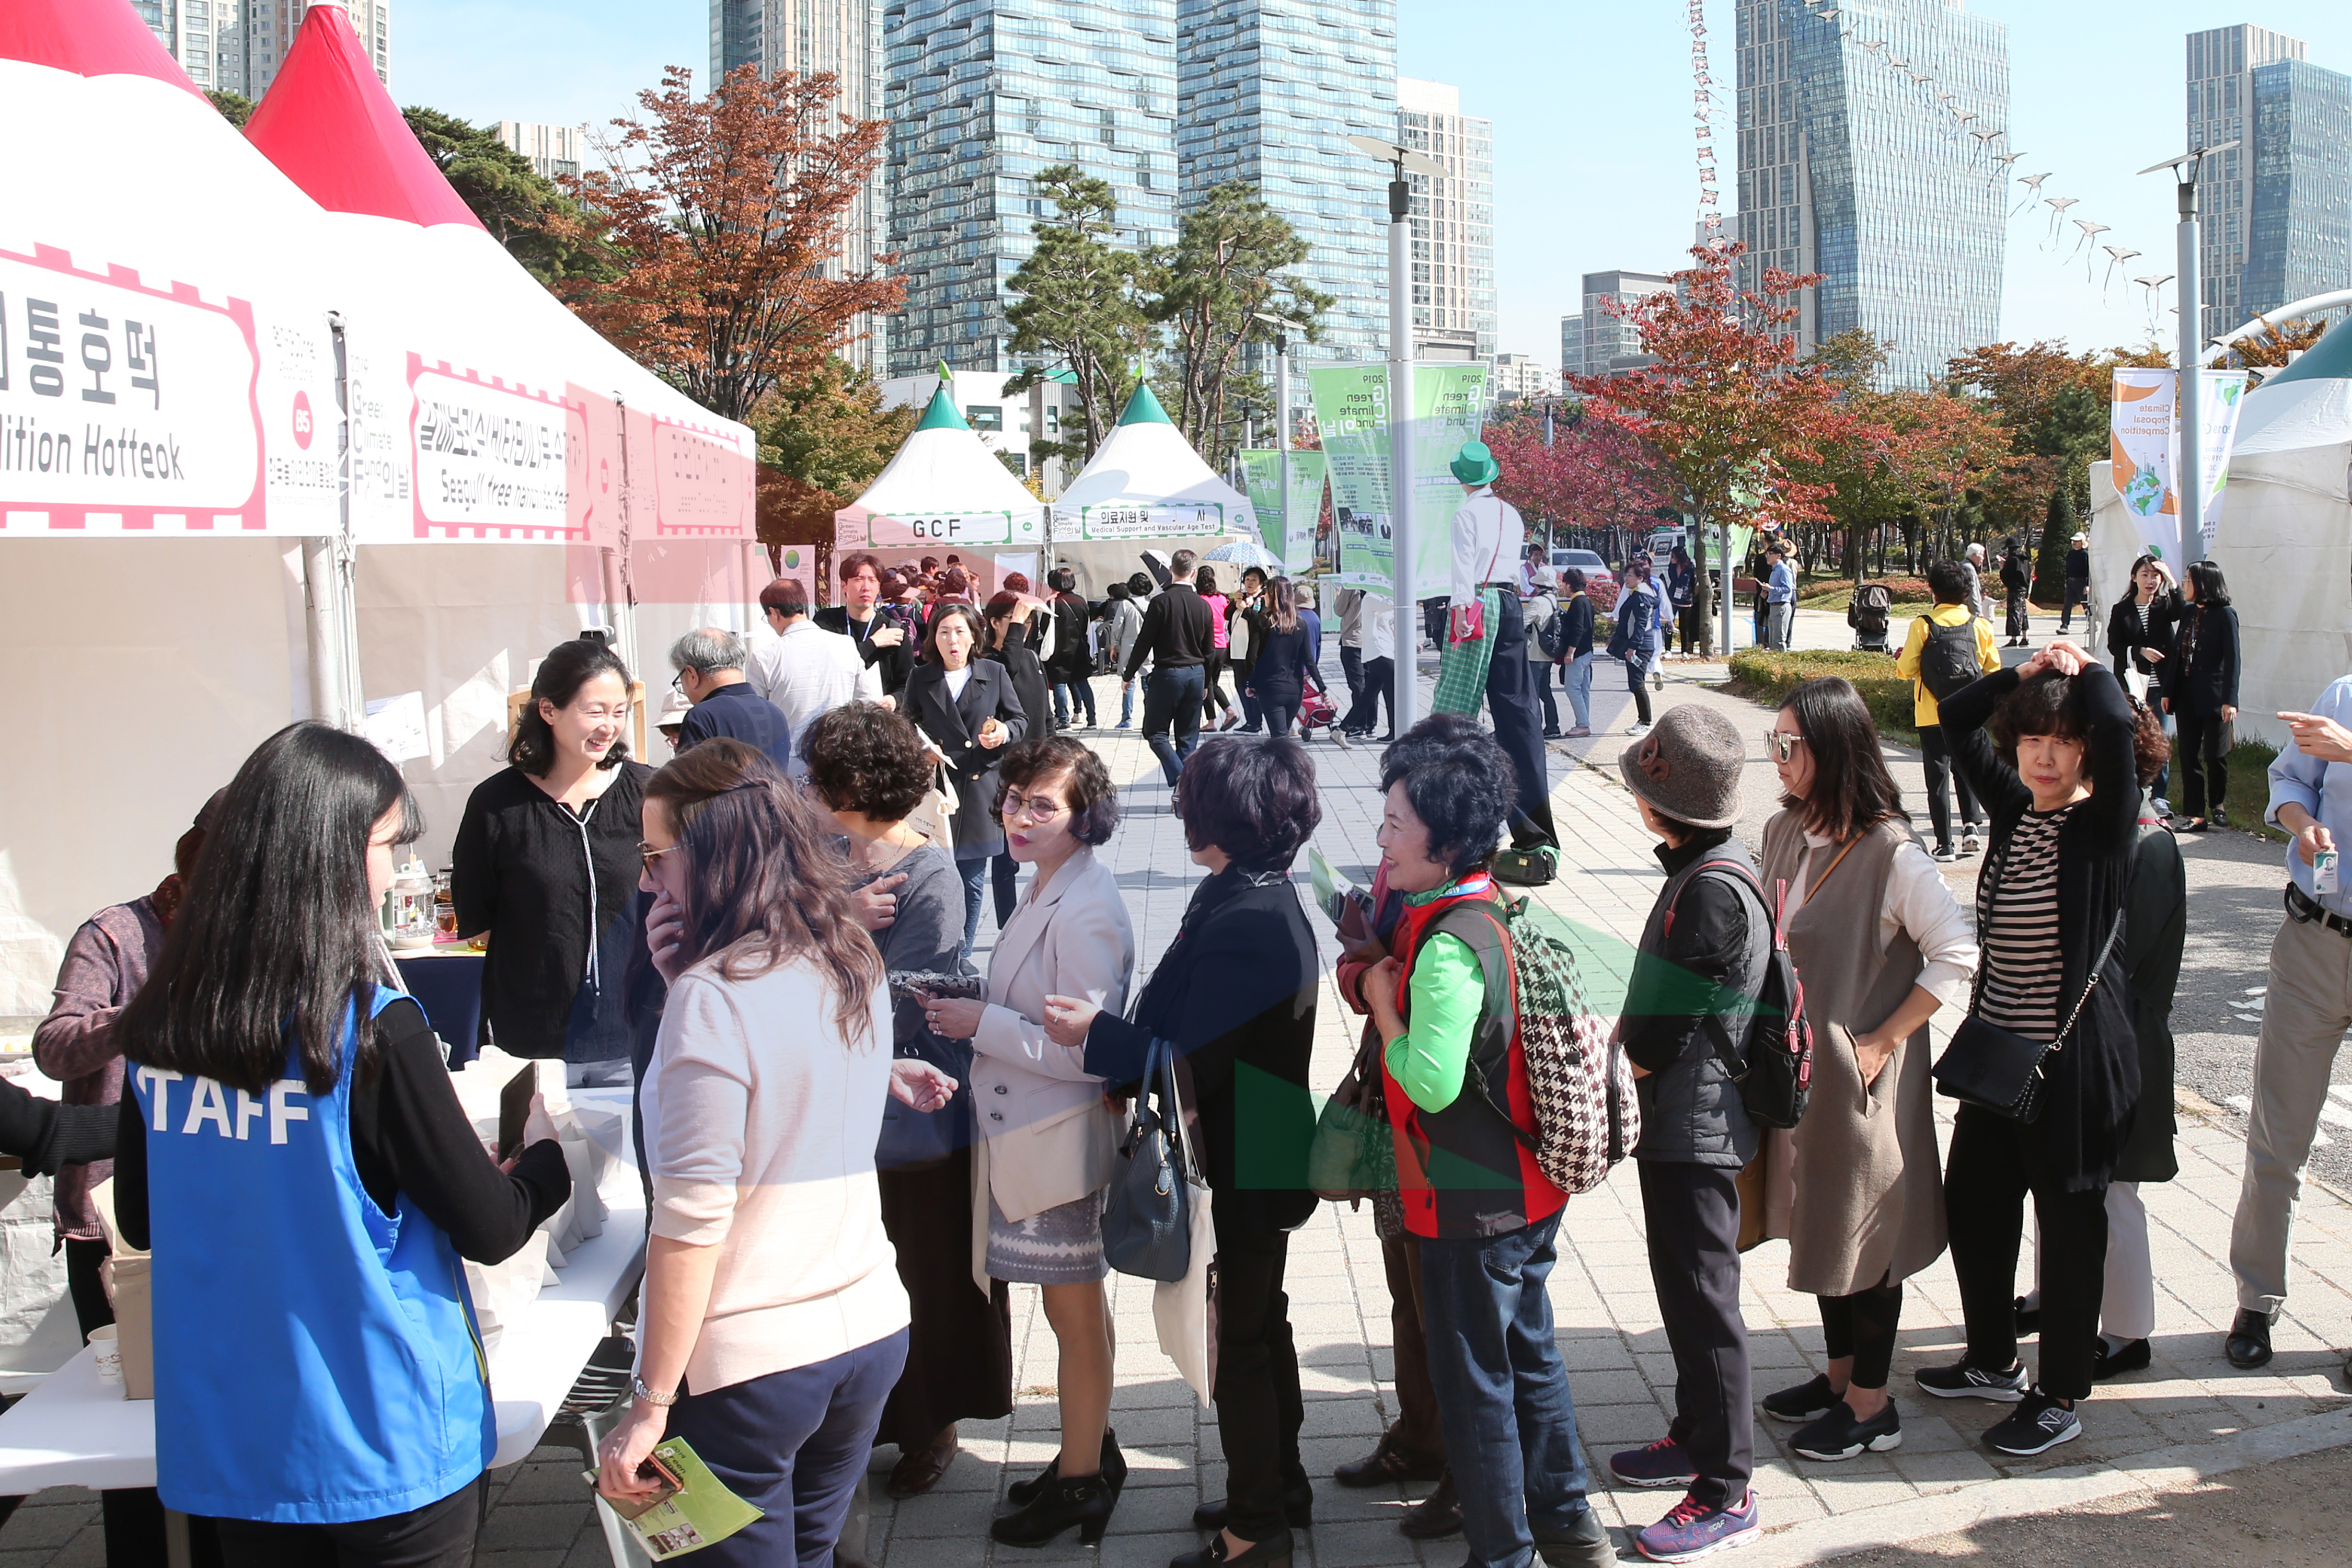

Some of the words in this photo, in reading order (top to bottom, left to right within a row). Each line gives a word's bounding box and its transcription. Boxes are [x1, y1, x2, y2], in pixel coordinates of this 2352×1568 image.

[0, 291, 159, 411] 통호떡
[351, 354, 369, 374] 2019
[296, 409, 309, 433] B5
[0, 413, 71, 473] ition
[84, 422, 185, 480] Hotteok
[352, 418, 392, 454] Climate
[442, 468, 485, 512] Seagull
[488, 475, 512, 506] tree
[913, 519, 961, 538] GCF
[1101, 511, 1136, 524] 의료지원
[1140, 510, 1149, 523] 및
[136, 1065, 308, 1145] TAFF
[662, 1447, 686, 1474] Green
[671, 1445, 686, 1459] 2019
